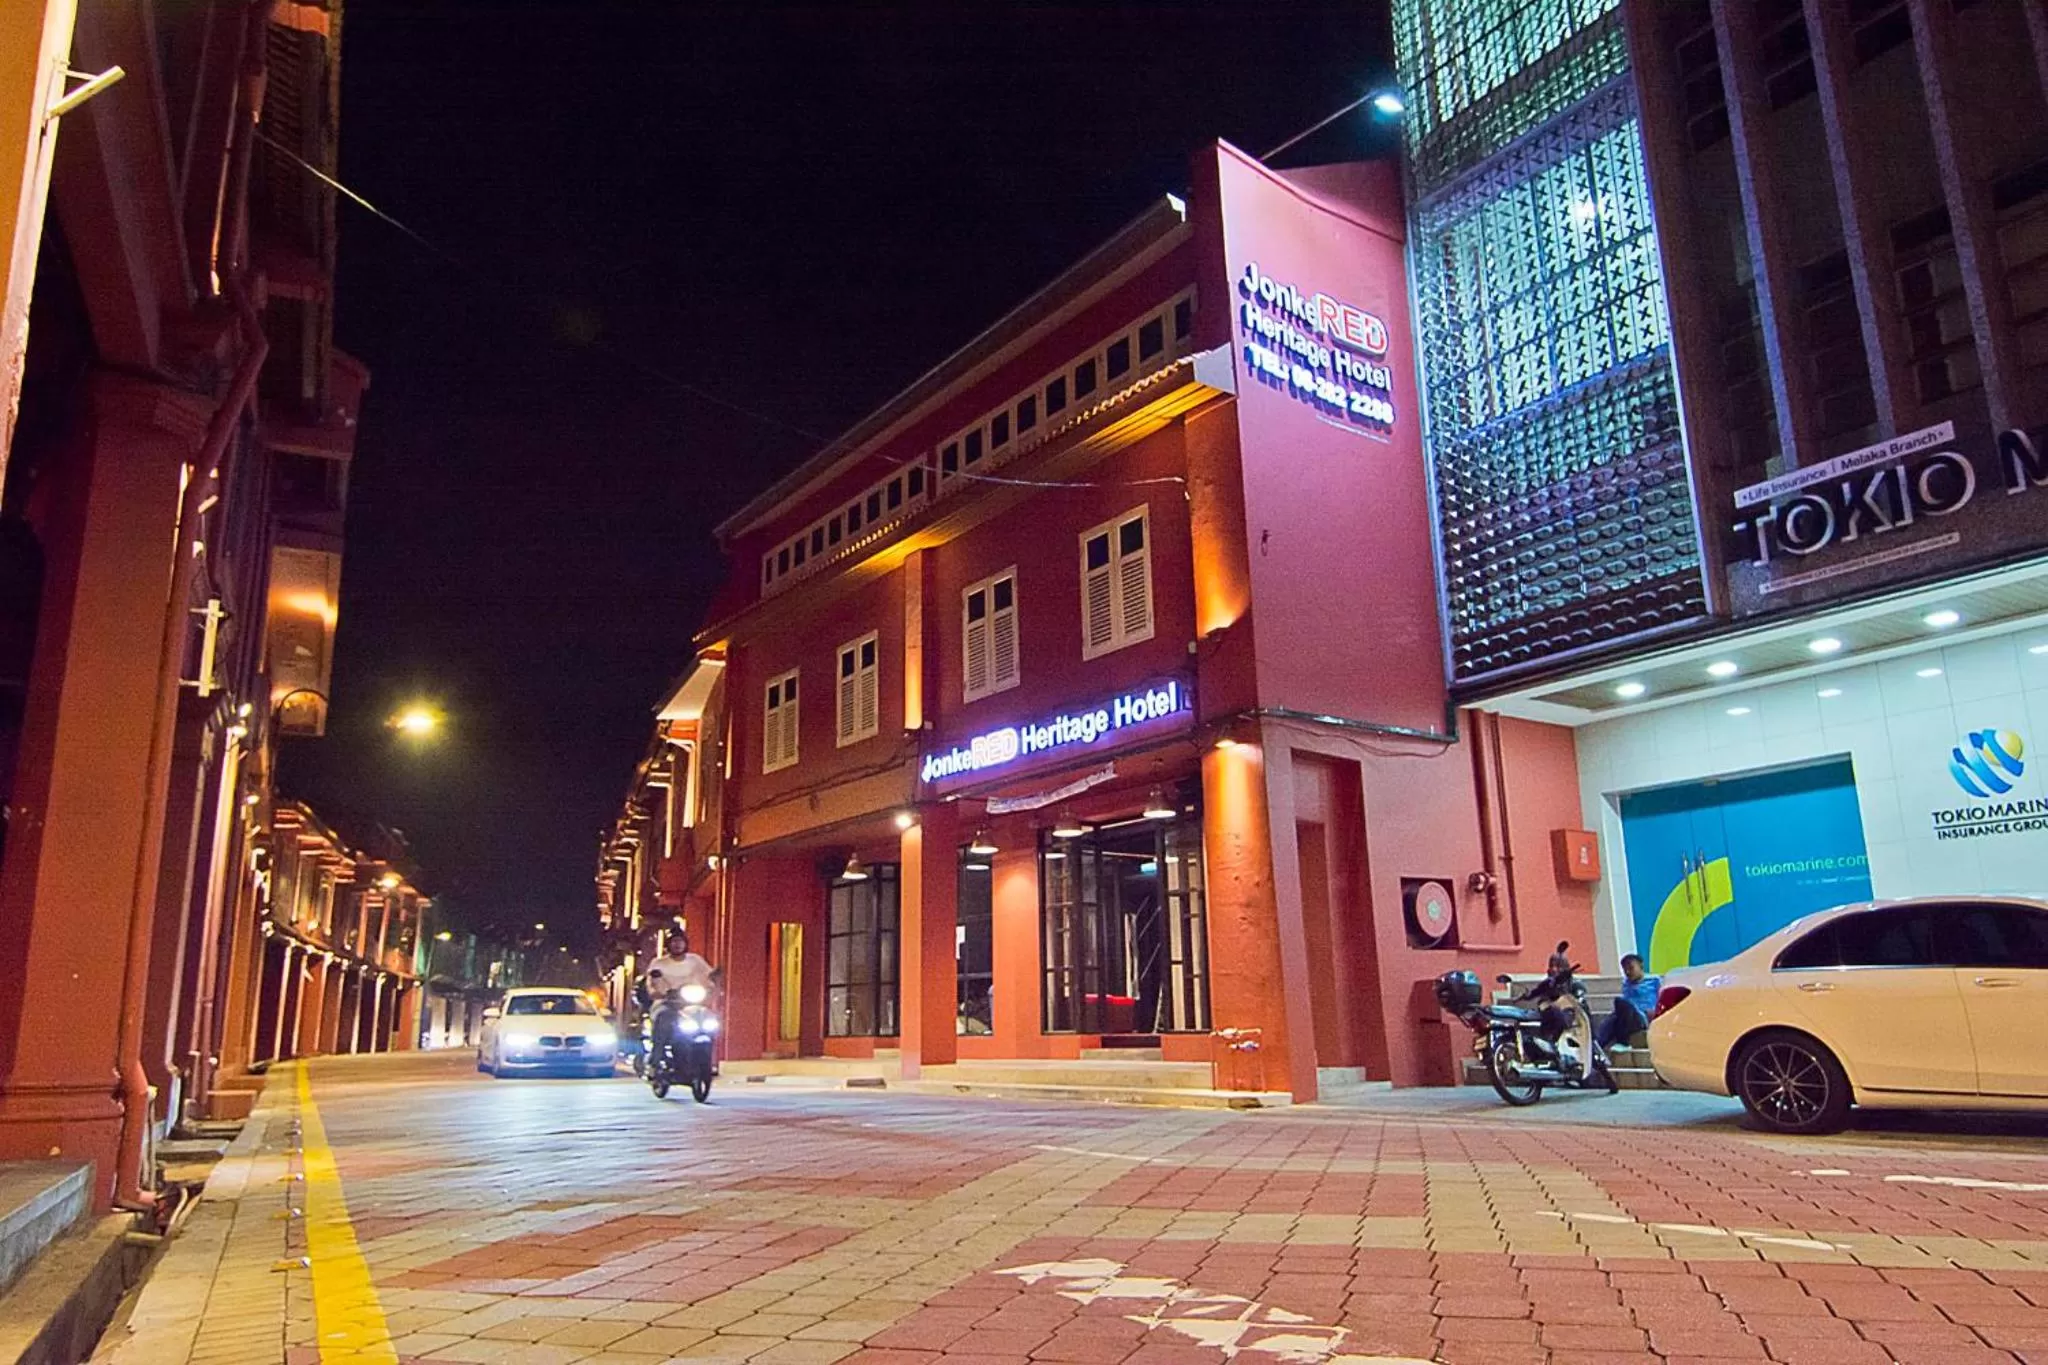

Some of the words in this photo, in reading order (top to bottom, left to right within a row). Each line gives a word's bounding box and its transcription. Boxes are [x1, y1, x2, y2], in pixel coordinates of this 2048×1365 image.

[1245, 302, 1331, 368] Heritage
[1334, 349, 1392, 391] Hotel
[1747, 484, 1770, 501] Life
[1771, 467, 1827, 494] Insurance
[1840, 447, 1887, 470] Melaka
[1889, 430, 1938, 455] Branch
[1733, 450, 1976, 567] TOKIO
[1021, 708, 1109, 755] Heritage
[1114, 680, 1177, 729] Hotel
[1932, 807, 1985, 825] TOKIO
[1937, 824, 2011, 841] INSURANCE
